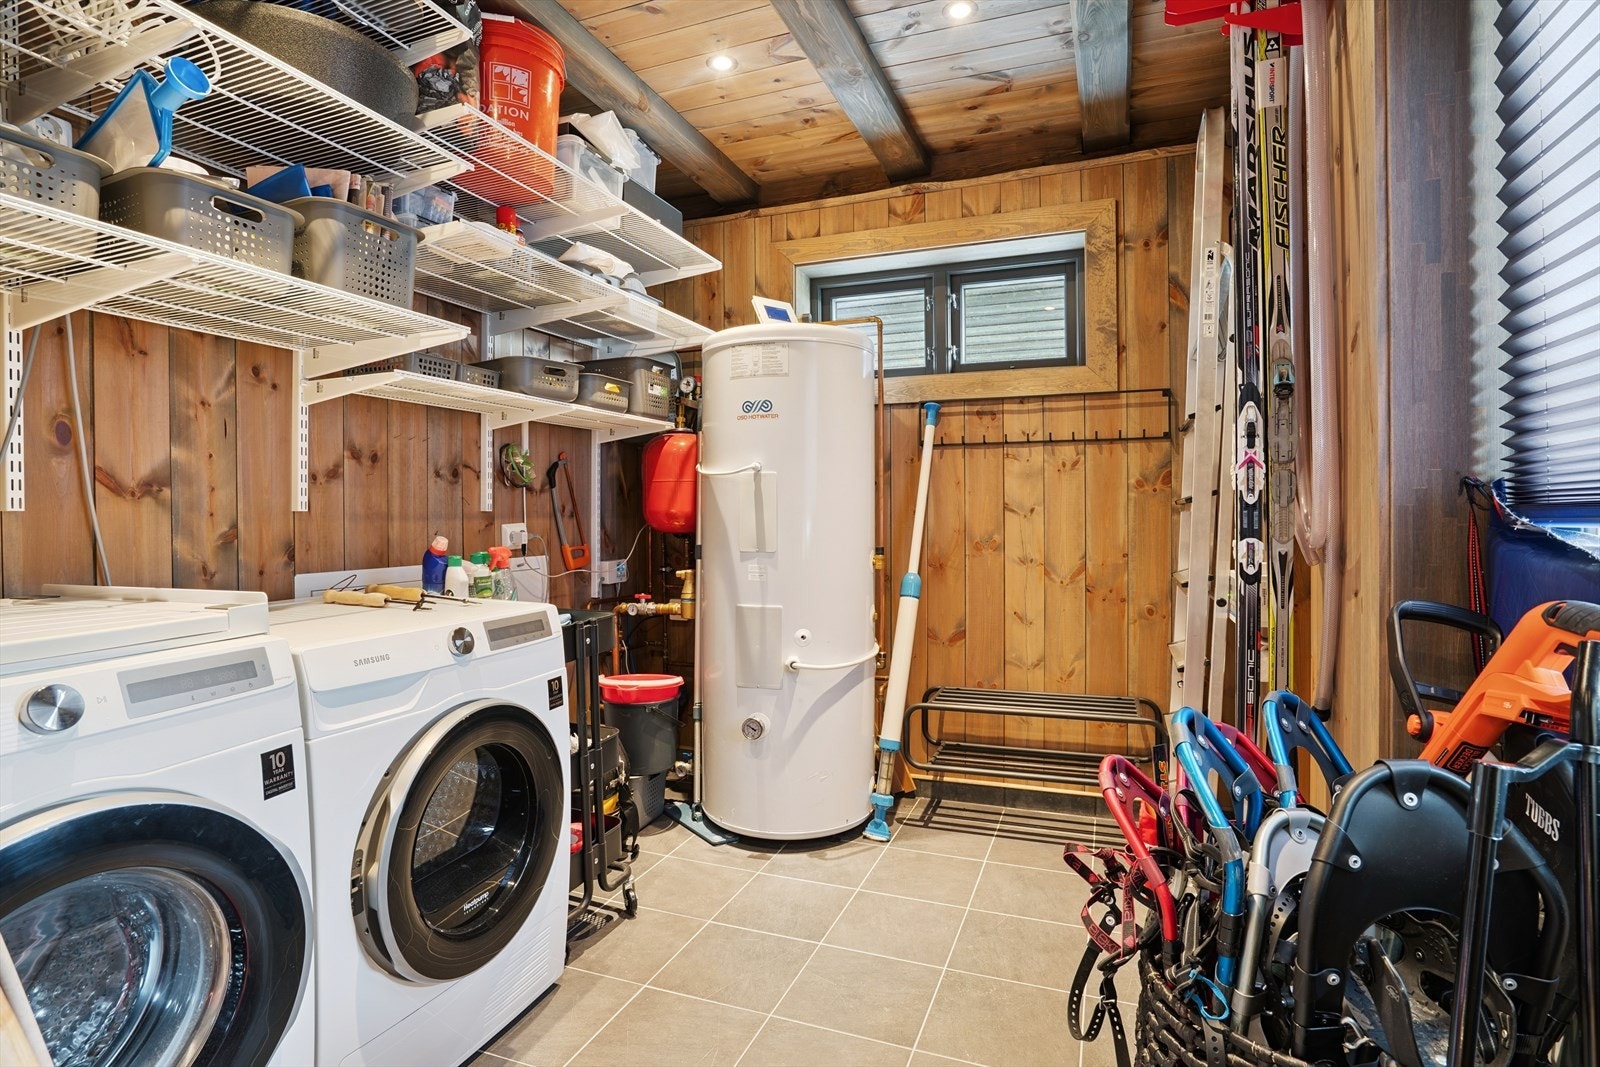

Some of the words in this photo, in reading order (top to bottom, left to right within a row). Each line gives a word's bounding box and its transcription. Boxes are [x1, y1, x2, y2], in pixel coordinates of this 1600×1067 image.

[1270, 126, 1290, 250] FISCHER
[353, 653, 391, 667] SAMSUNG
[550, 680, 559, 691] 10
[269, 751, 286, 770] 10
[1452, 748, 1473, 769] DECKER
[264, 771, 294, 785] WARRANTY
[1525, 792, 1560, 841] TUBBS
